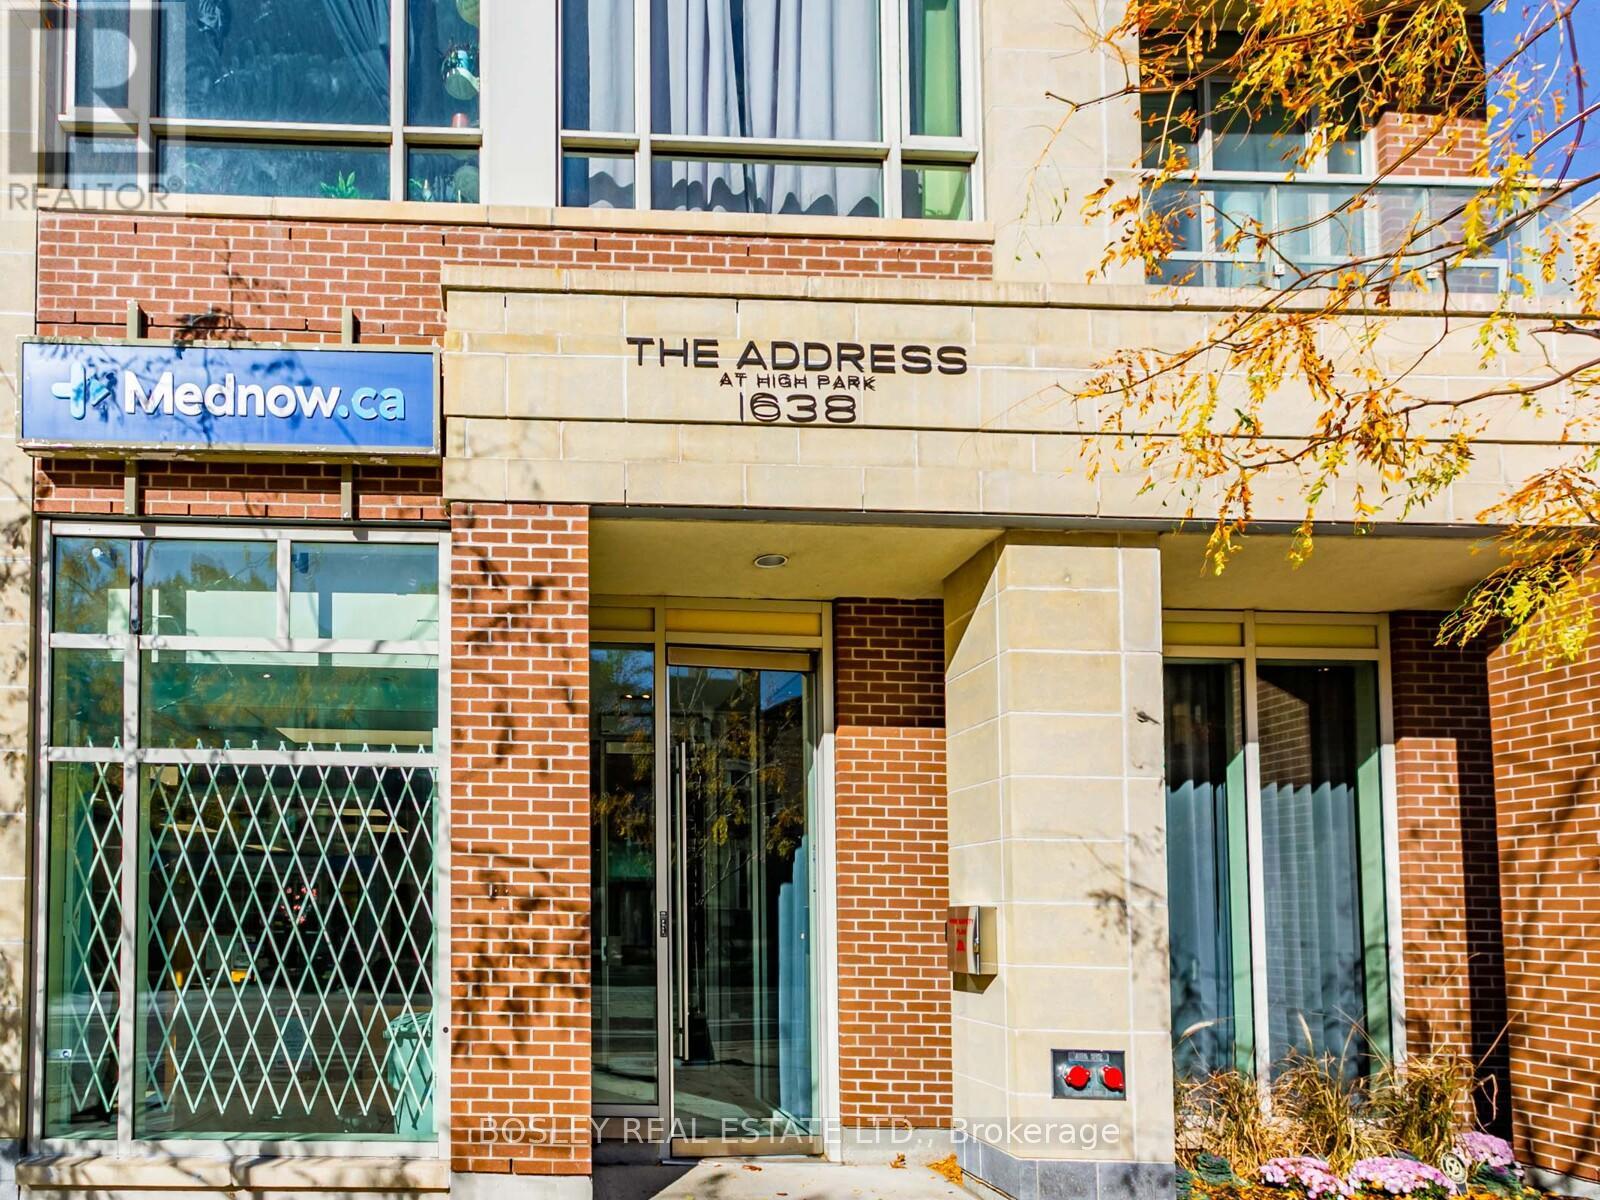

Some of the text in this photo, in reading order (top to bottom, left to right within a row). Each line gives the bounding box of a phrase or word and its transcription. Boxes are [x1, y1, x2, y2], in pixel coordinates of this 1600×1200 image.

[626, 337, 968, 375] THE ADDRESS
[124, 371, 406, 421] Mednow.ca
[719, 372, 876, 392] AT HIGH PARK
[738, 391, 857, 424] 1638
